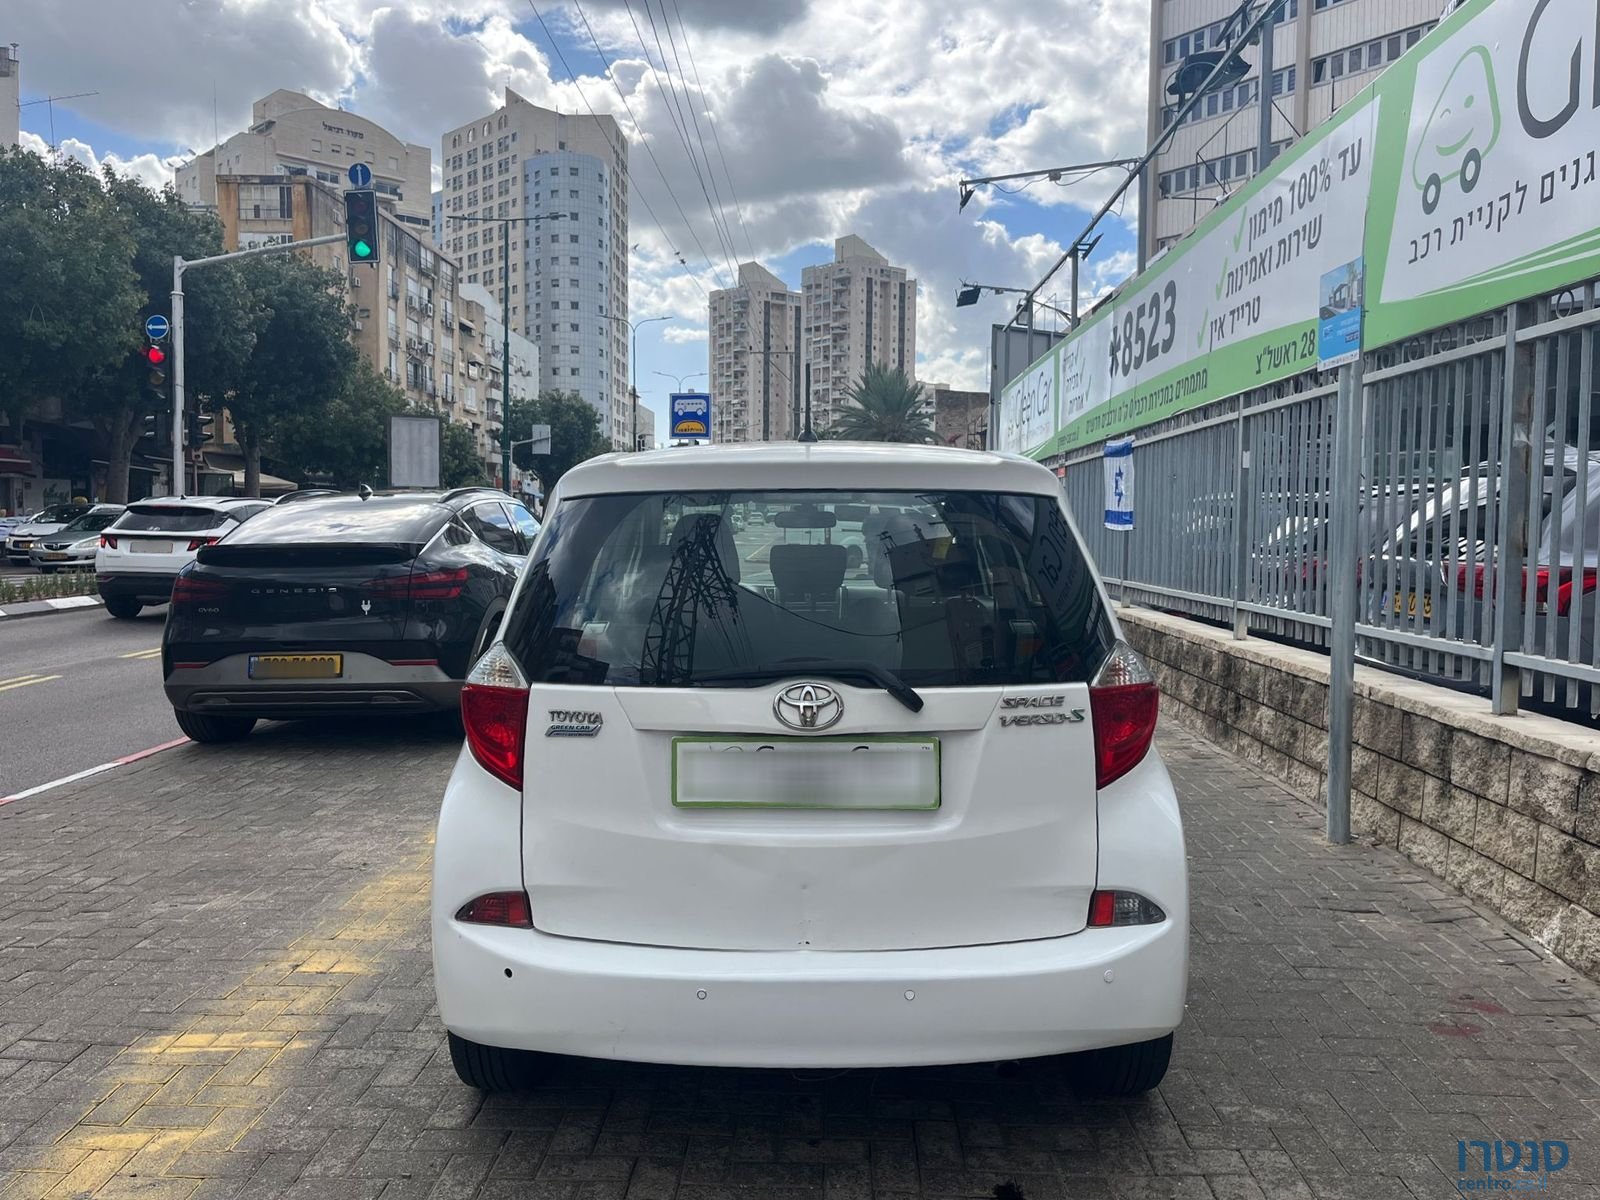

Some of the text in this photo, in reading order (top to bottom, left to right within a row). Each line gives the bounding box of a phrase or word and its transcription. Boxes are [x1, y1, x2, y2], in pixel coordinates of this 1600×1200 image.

[1248, 137, 1363, 252] עד 100% מימון
[1449, 179, 1528, 246] לקניית
[1225, 213, 1323, 299] שירות ואמינות
[1407, 226, 1442, 265] רכב
[1209, 295, 1261, 352] טרייד אין
[1299, 328, 1316, 361] 28
[1148, 384, 1174, 412] במכירת
[1175, 367, 1208, 400] מתמחים
[548, 711, 603, 724] TOYOTA
[999, 708, 1085, 728] VERSO-S
[1000, 695, 1066, 709] SPACE
